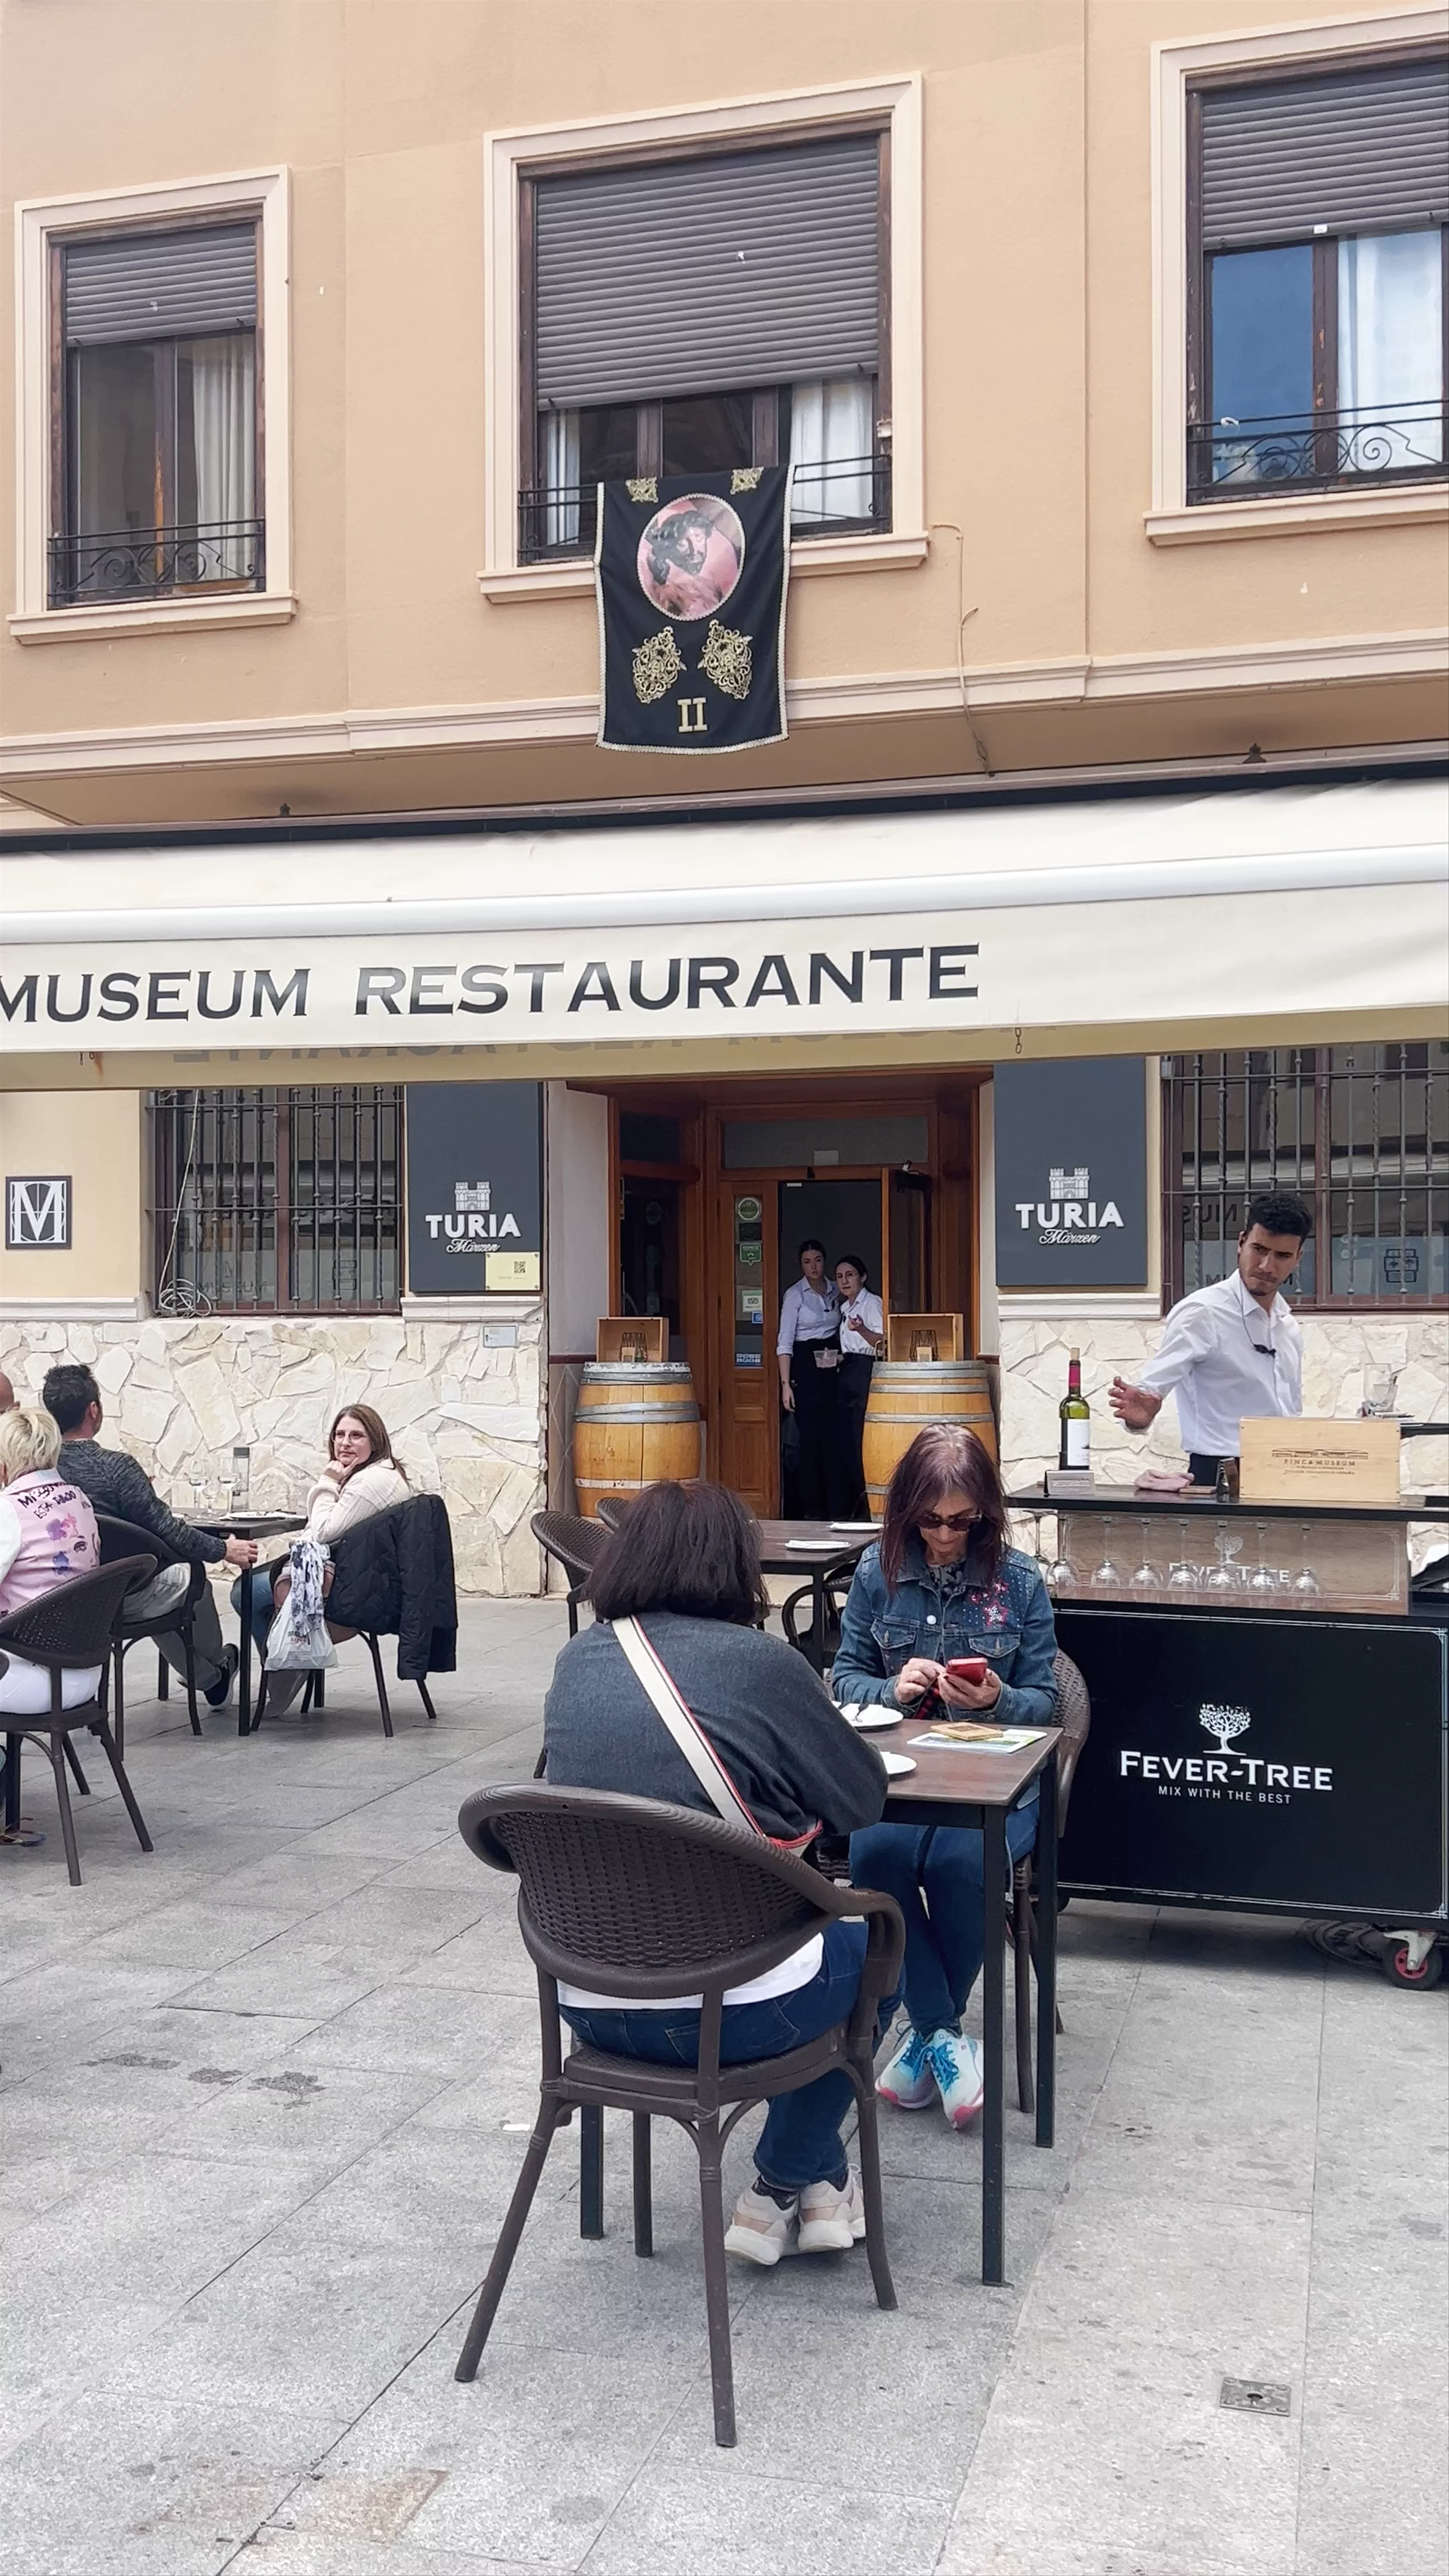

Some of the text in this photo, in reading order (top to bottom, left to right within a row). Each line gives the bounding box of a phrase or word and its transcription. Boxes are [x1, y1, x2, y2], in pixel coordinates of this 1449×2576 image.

[0, 942, 980, 1023] MUSEUM RESTAURANTE
[425, 1213, 521, 1238] TURIA
[1015, 1201, 1124, 1229] TURIA
[1039, 1229, 1101, 1244] Märzen
[1120, 1750, 1333, 1791] FEVER-TREE
[1158, 1786, 1292, 1804] MIX WITH THE BEST
